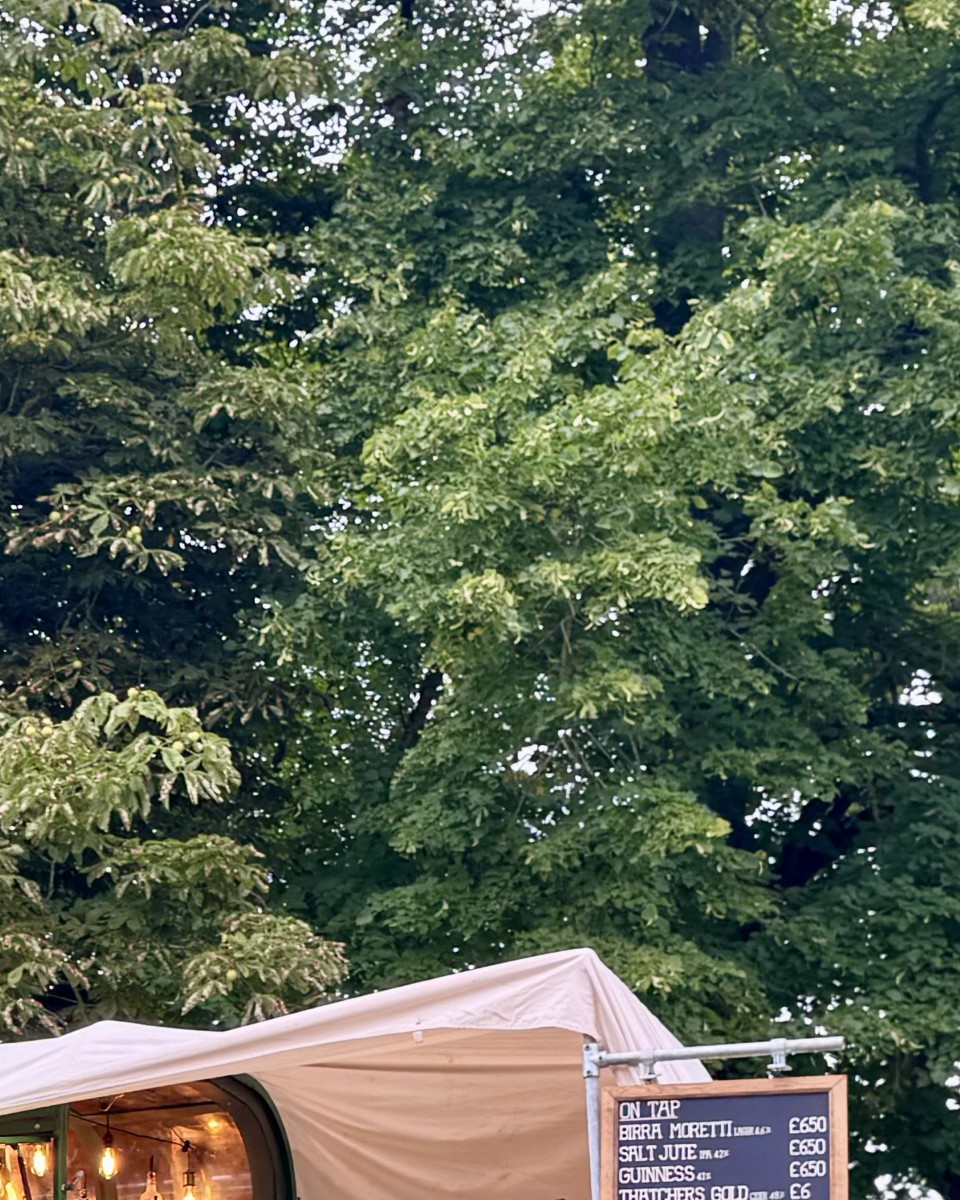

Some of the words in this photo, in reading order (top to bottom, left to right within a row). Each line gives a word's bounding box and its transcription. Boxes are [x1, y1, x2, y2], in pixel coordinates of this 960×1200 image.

[620, 1102, 640, 1119] ON
[647, 1100, 680, 1118] TAP
[618, 1122, 662, 1140] BIRRA
[670, 1120, 733, 1138] MORETTI
[618, 1146, 656, 1161] SALT
[658, 1144, 697, 1160] JUTE
[618, 1166, 695, 1184] GUINNESS
[790, 1183, 811, 1200] £6
